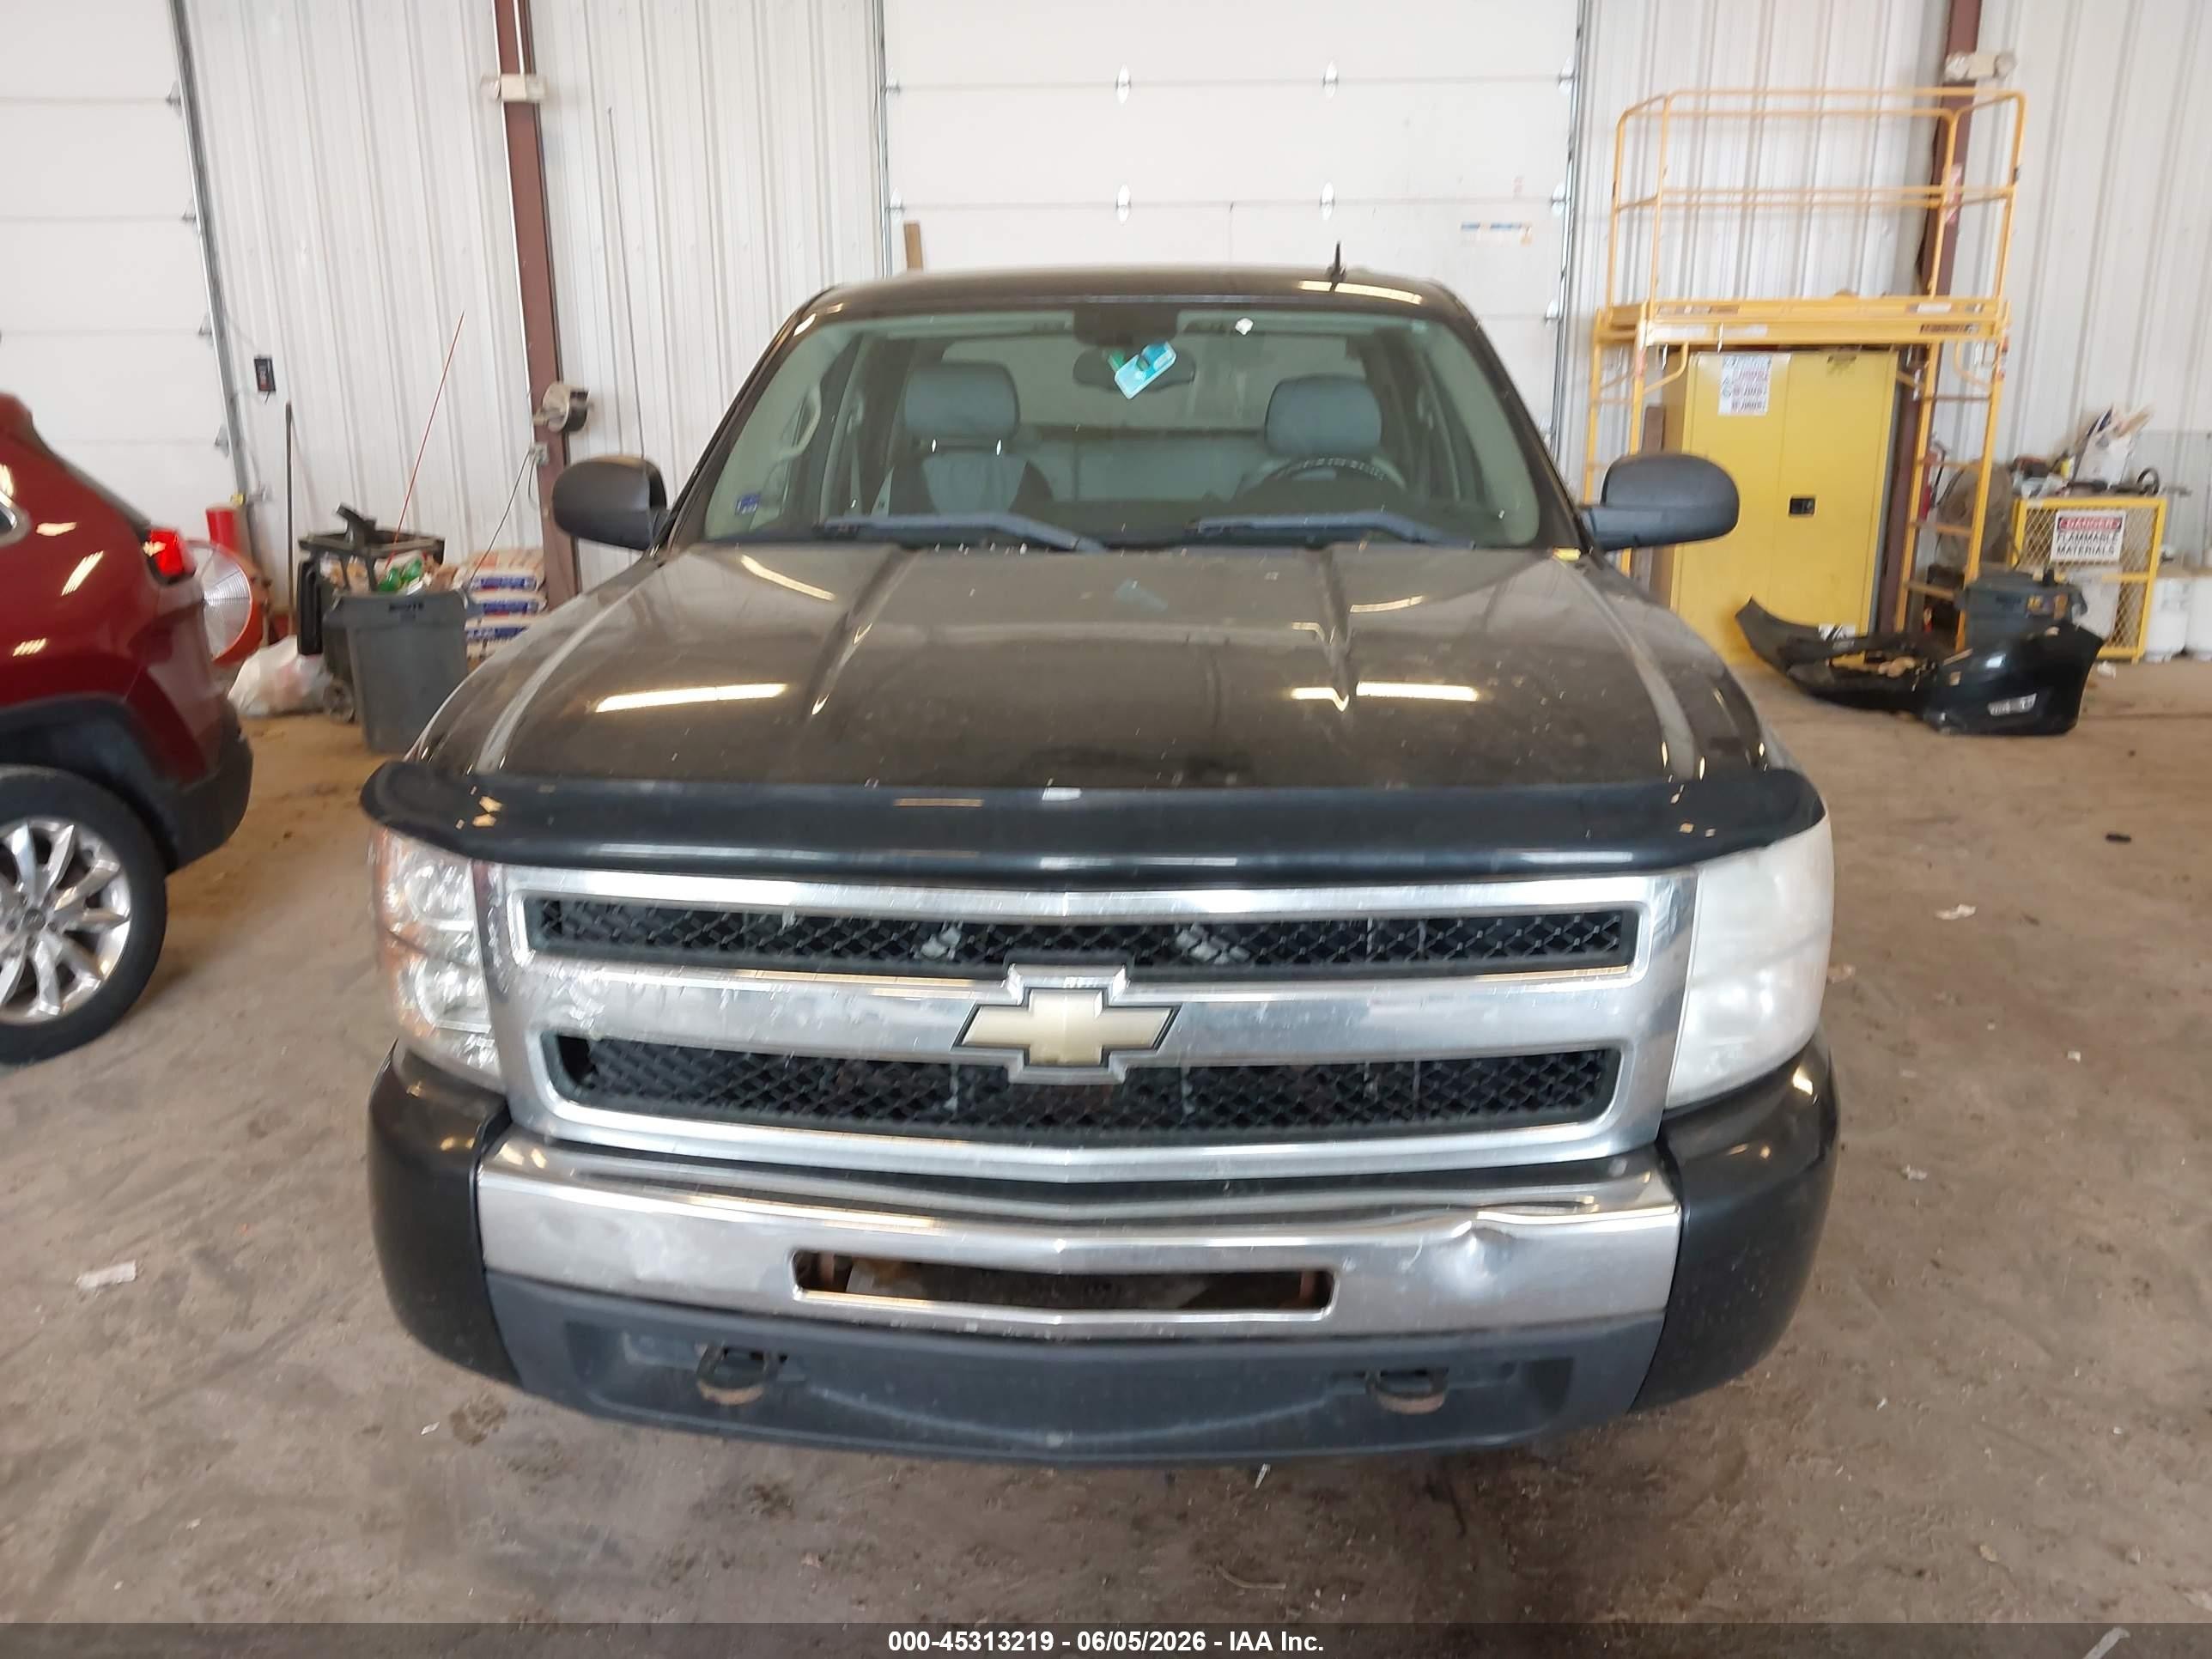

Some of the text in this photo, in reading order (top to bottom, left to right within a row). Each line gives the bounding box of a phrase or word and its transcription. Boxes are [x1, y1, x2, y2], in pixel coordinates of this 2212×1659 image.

[2066, 517, 2114, 529] DANGER
[2057, 532, 2118, 544] FLAMMABLE
[2057, 544, 2115, 556] MATERIALS
